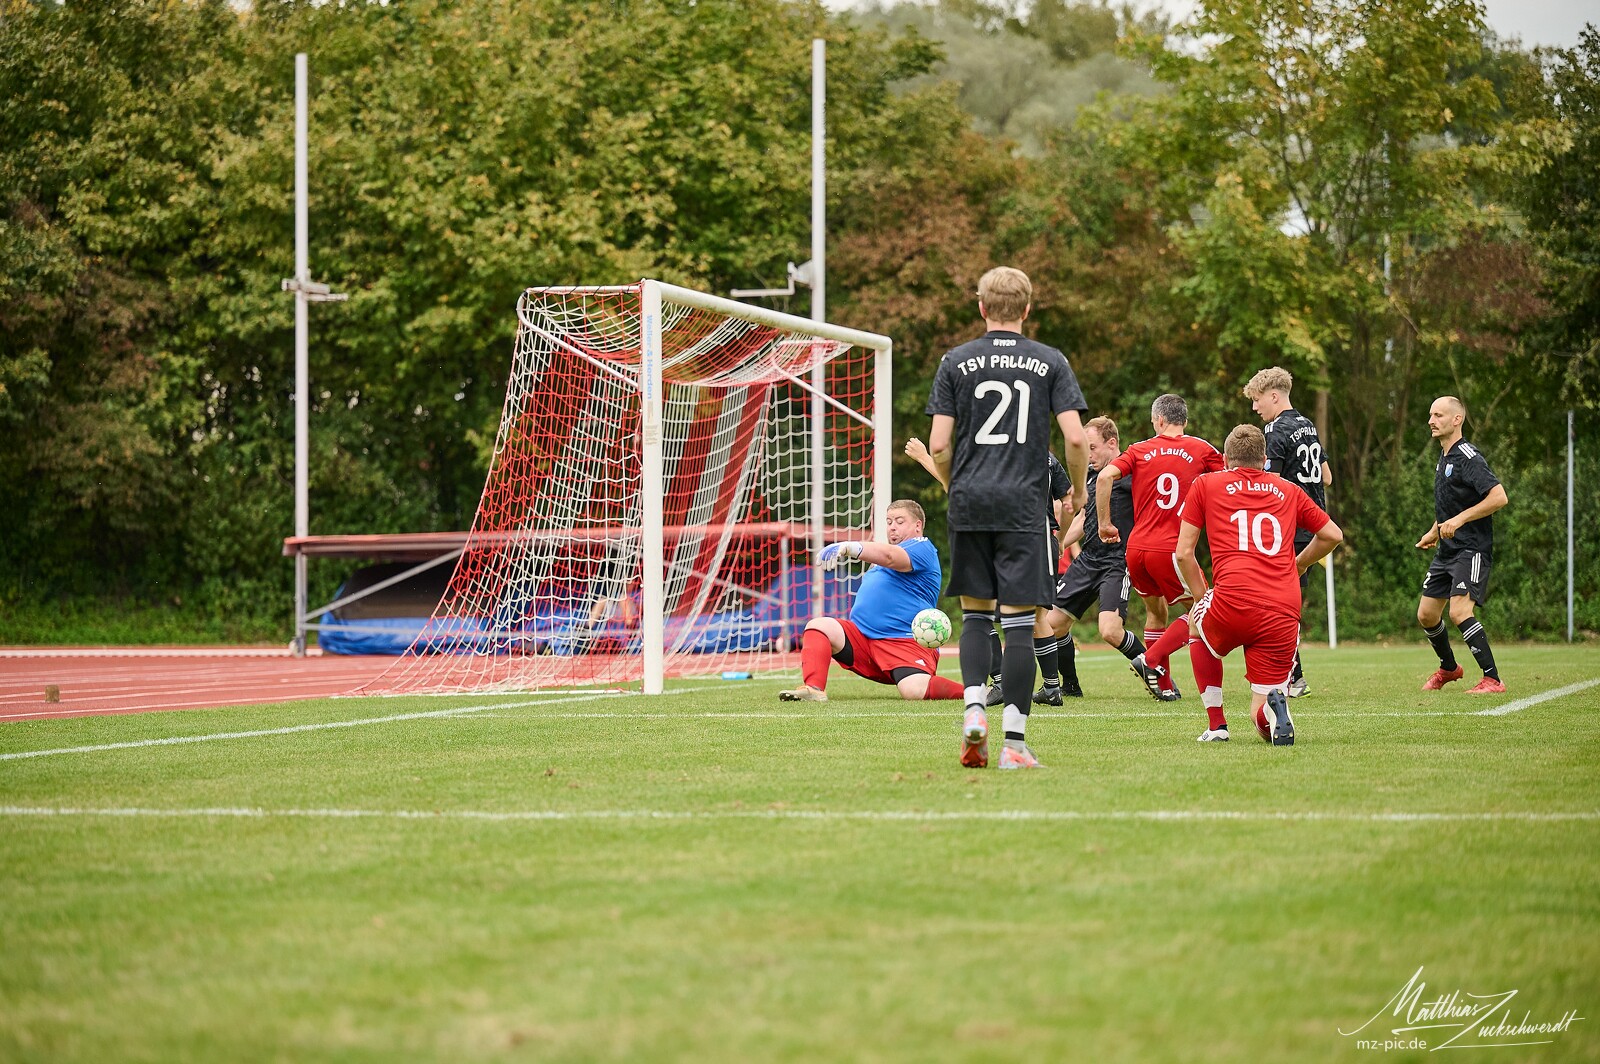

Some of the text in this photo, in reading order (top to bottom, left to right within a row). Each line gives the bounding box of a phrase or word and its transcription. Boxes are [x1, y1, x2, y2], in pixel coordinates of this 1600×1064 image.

[957, 355, 1049, 377] TSV PALLING
[974, 379, 1030, 445] 21
[1289, 428, 1302, 443] TSV
[1143, 447, 1193, 464] SV Laufen
[1296, 442, 1321, 484] 38
[1156, 473, 1180, 510] 9
[1225, 480, 1285, 501] SV Laufen
[1230, 509, 1283, 556] 10
